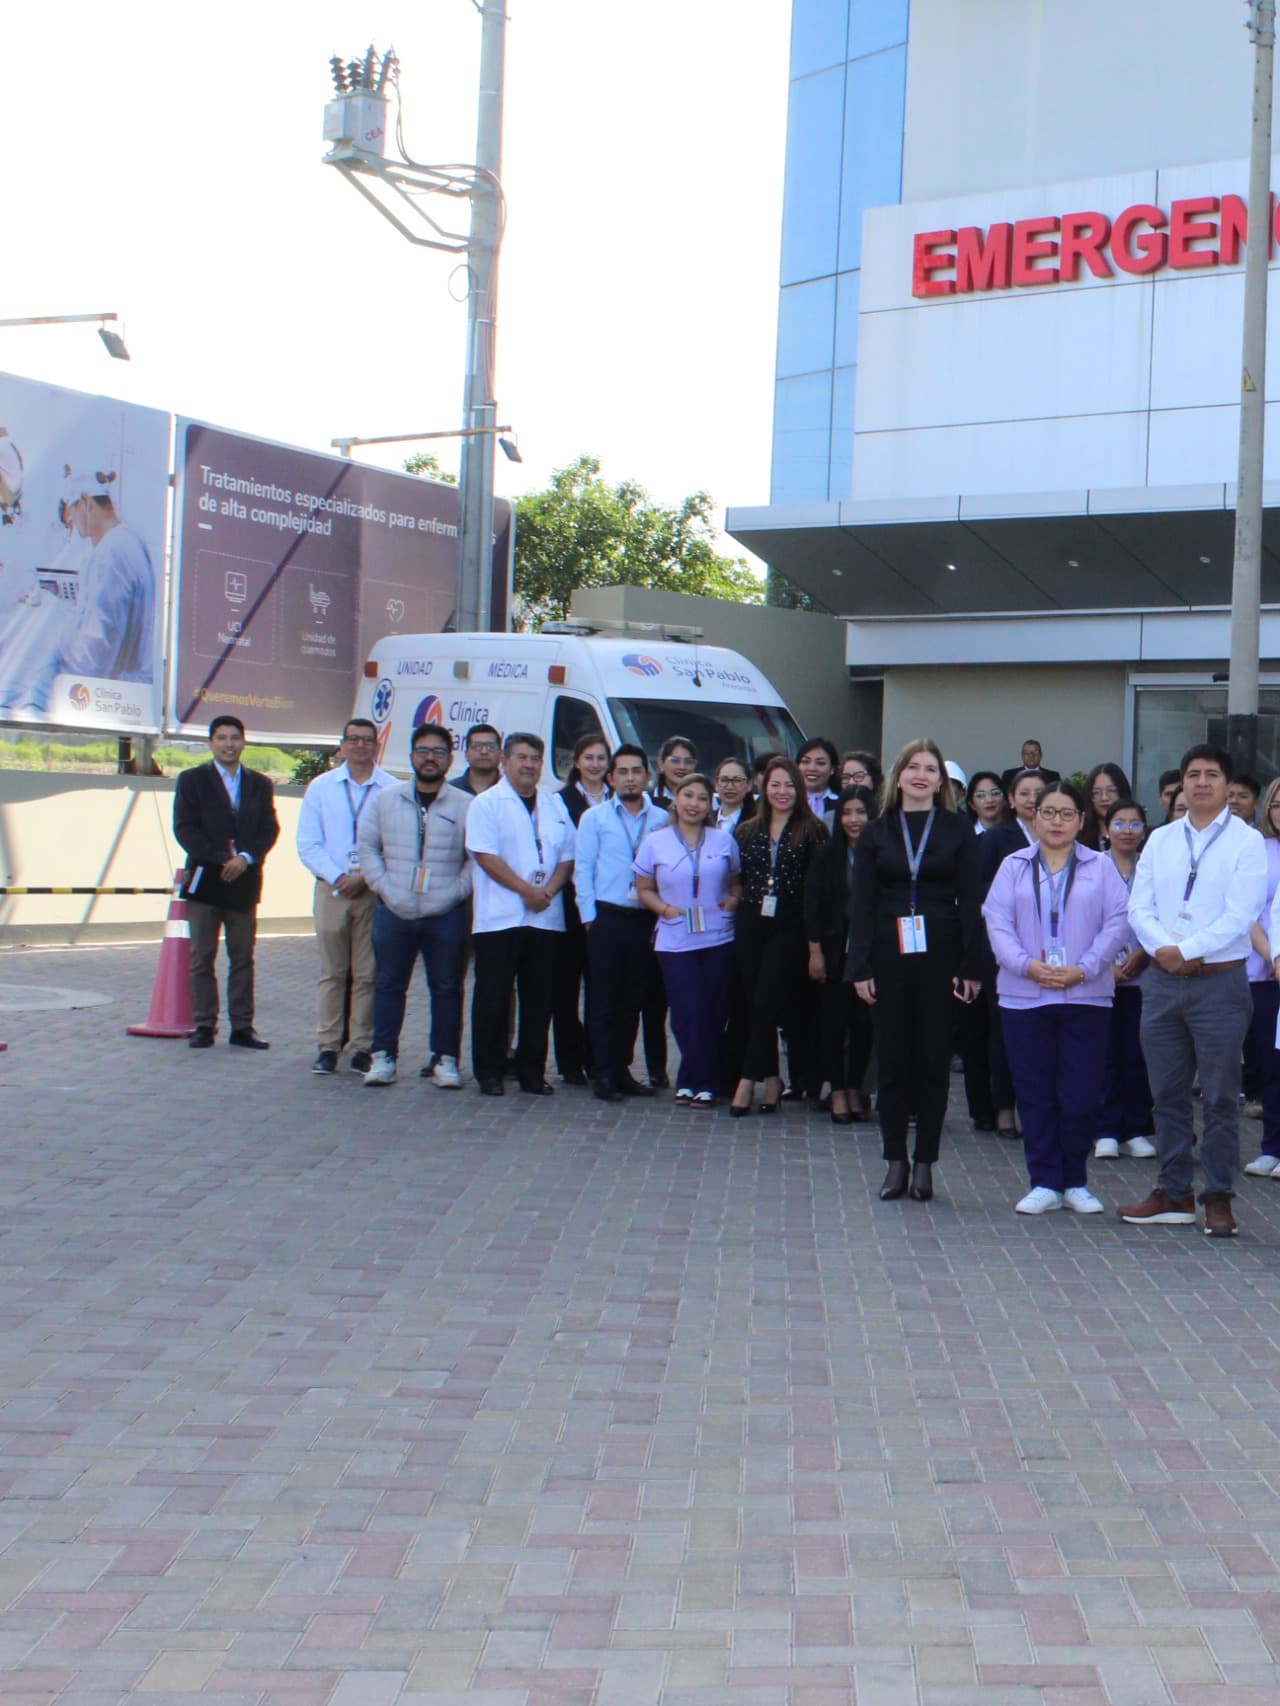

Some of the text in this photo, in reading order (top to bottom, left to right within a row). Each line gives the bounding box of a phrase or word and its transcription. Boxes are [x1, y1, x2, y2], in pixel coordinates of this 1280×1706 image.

[200, 464, 292, 504] Tratamientos
[294, 491, 386, 524] especializados
[388, 510, 415, 529] para
[199, 492, 332, 536] de alta complejidad
[397, 660, 433, 676] UNIDAD
[672, 665, 751, 684] San Pablo
